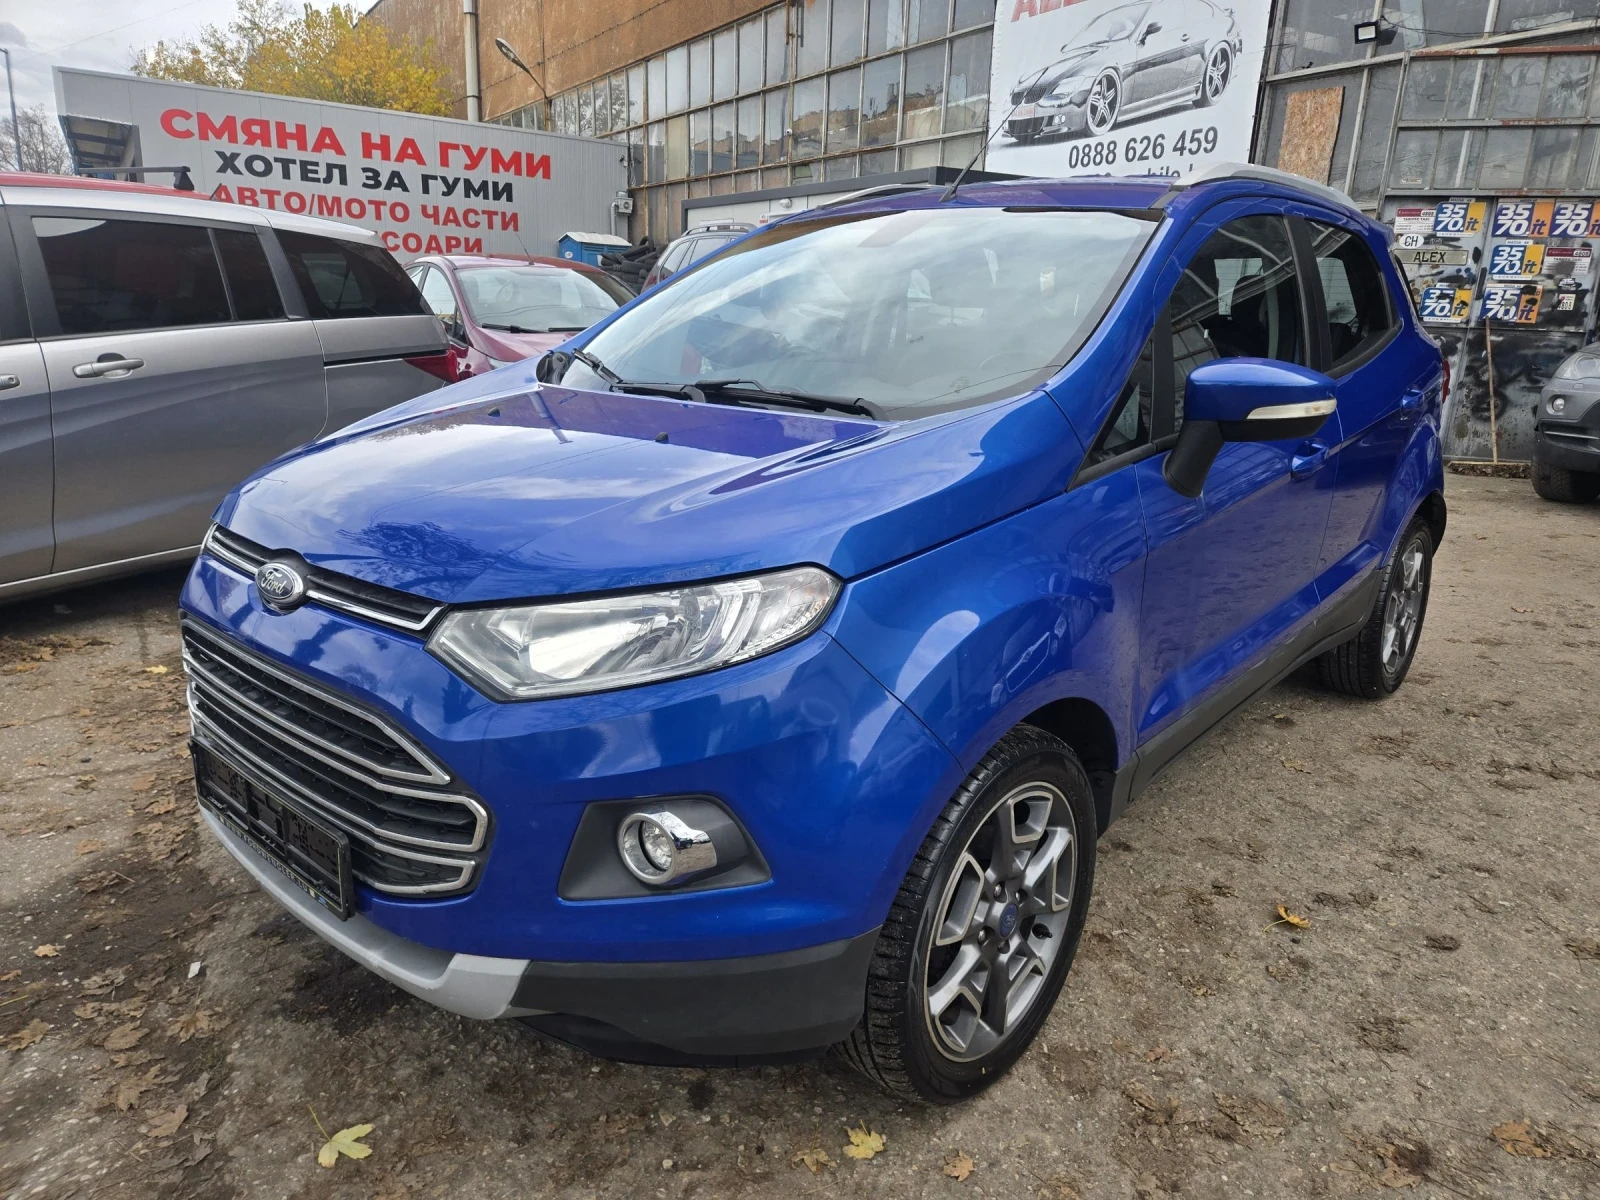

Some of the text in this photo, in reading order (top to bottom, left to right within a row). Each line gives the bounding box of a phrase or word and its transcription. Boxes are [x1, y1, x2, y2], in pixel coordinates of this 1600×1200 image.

[160, 108, 551, 180] СМЯНА НА ГУМИ
[1068, 126, 1218, 169] 0888 626 459
[214, 150, 513, 202] ХОТЕЛ ЗА ГУМИ
[213, 184, 519, 232] АВТО/МОТО ЧАСТИ
[1438, 203, 1467, 218] 35
[1497, 203, 1532, 220] 35
[1555, 203, 1592, 220] 35
[375, 230, 483, 254] СОАРИ
[1404, 235, 1419, 247] CH
[1413, 251, 1447, 263] ALEX
[1494, 247, 1525, 261] 35
[1486, 290, 1520, 305] 35
[261, 569, 287, 594] Ford
